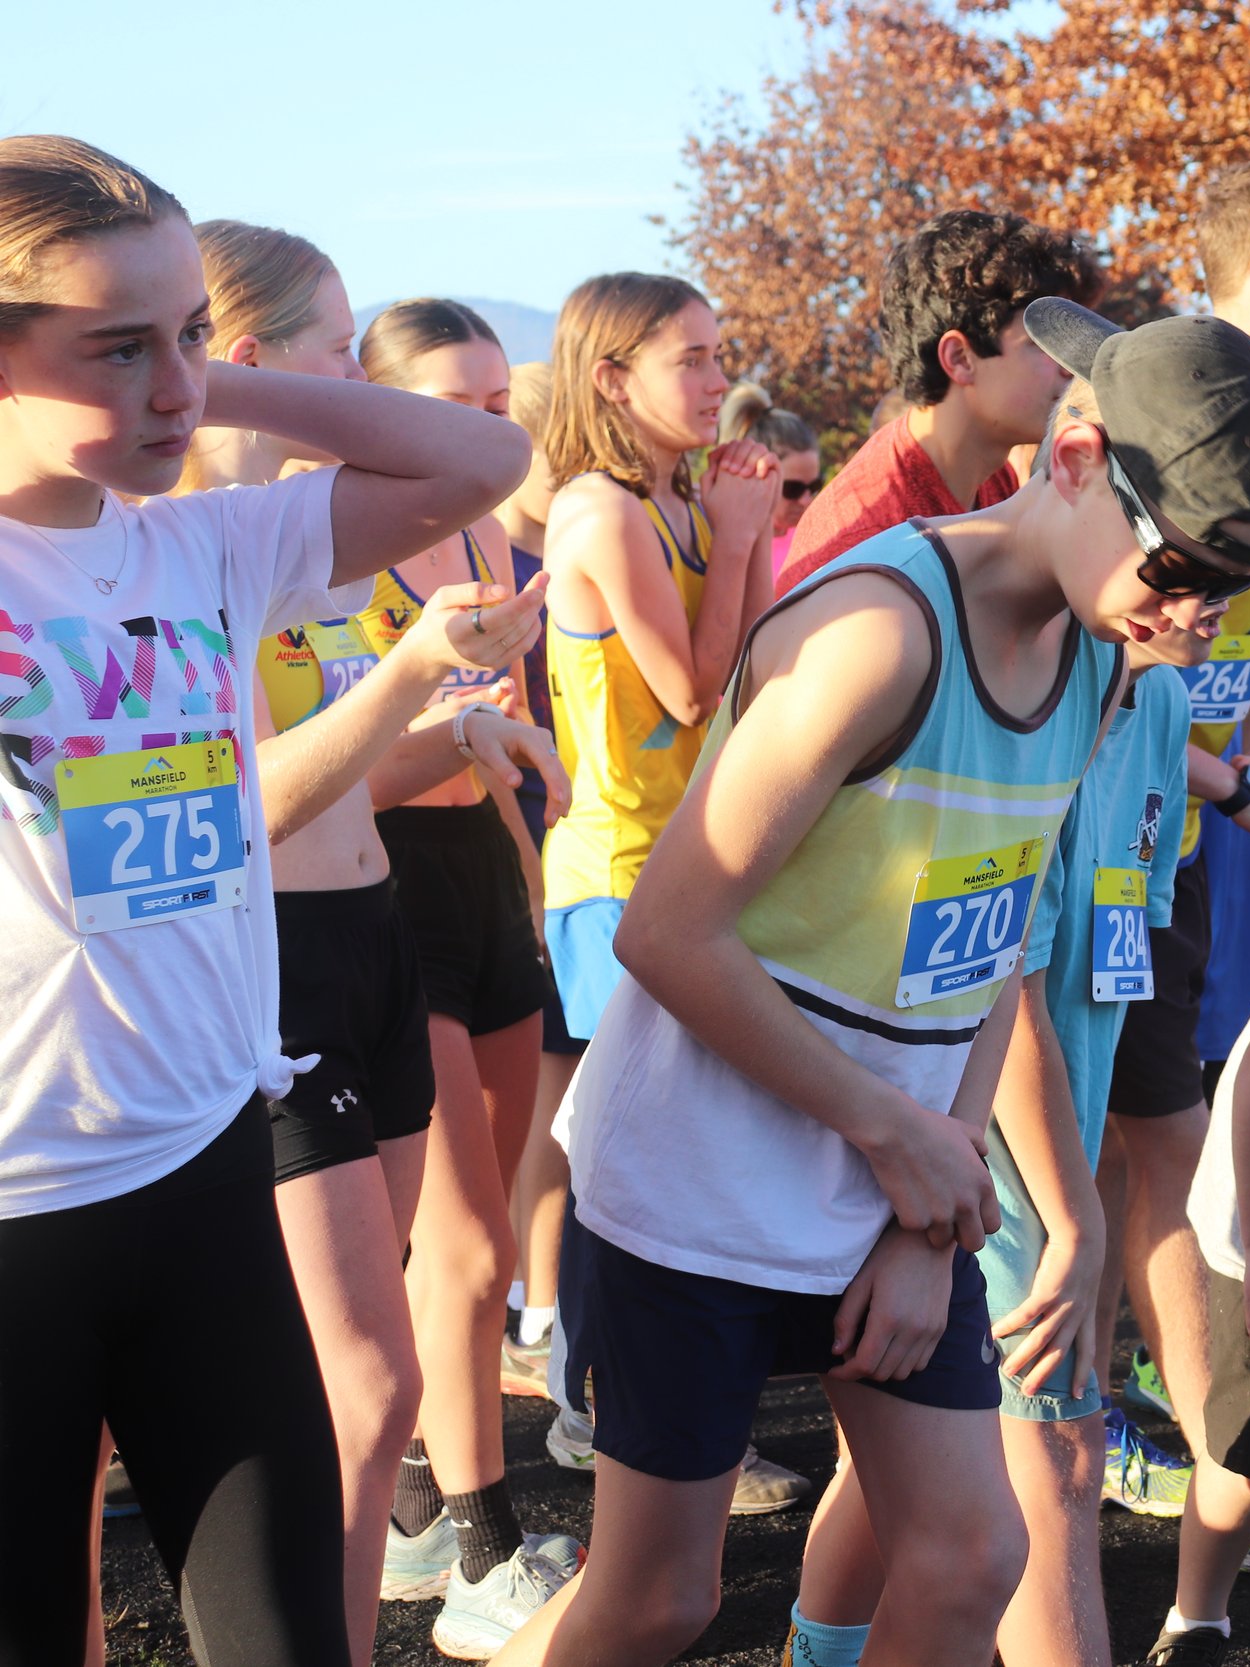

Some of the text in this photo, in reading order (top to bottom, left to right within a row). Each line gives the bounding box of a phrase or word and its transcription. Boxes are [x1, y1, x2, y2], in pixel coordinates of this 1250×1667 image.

[207, 750, 215, 764] 5
[130, 771, 187, 788] MANSFIELD
[145, 785, 178, 795] MARATHON
[103, 795, 220, 885] 275
[963, 869, 1004, 885] MANSFIELD
[926, 887, 1014, 967] 270
[1107, 909, 1146, 968] 284
